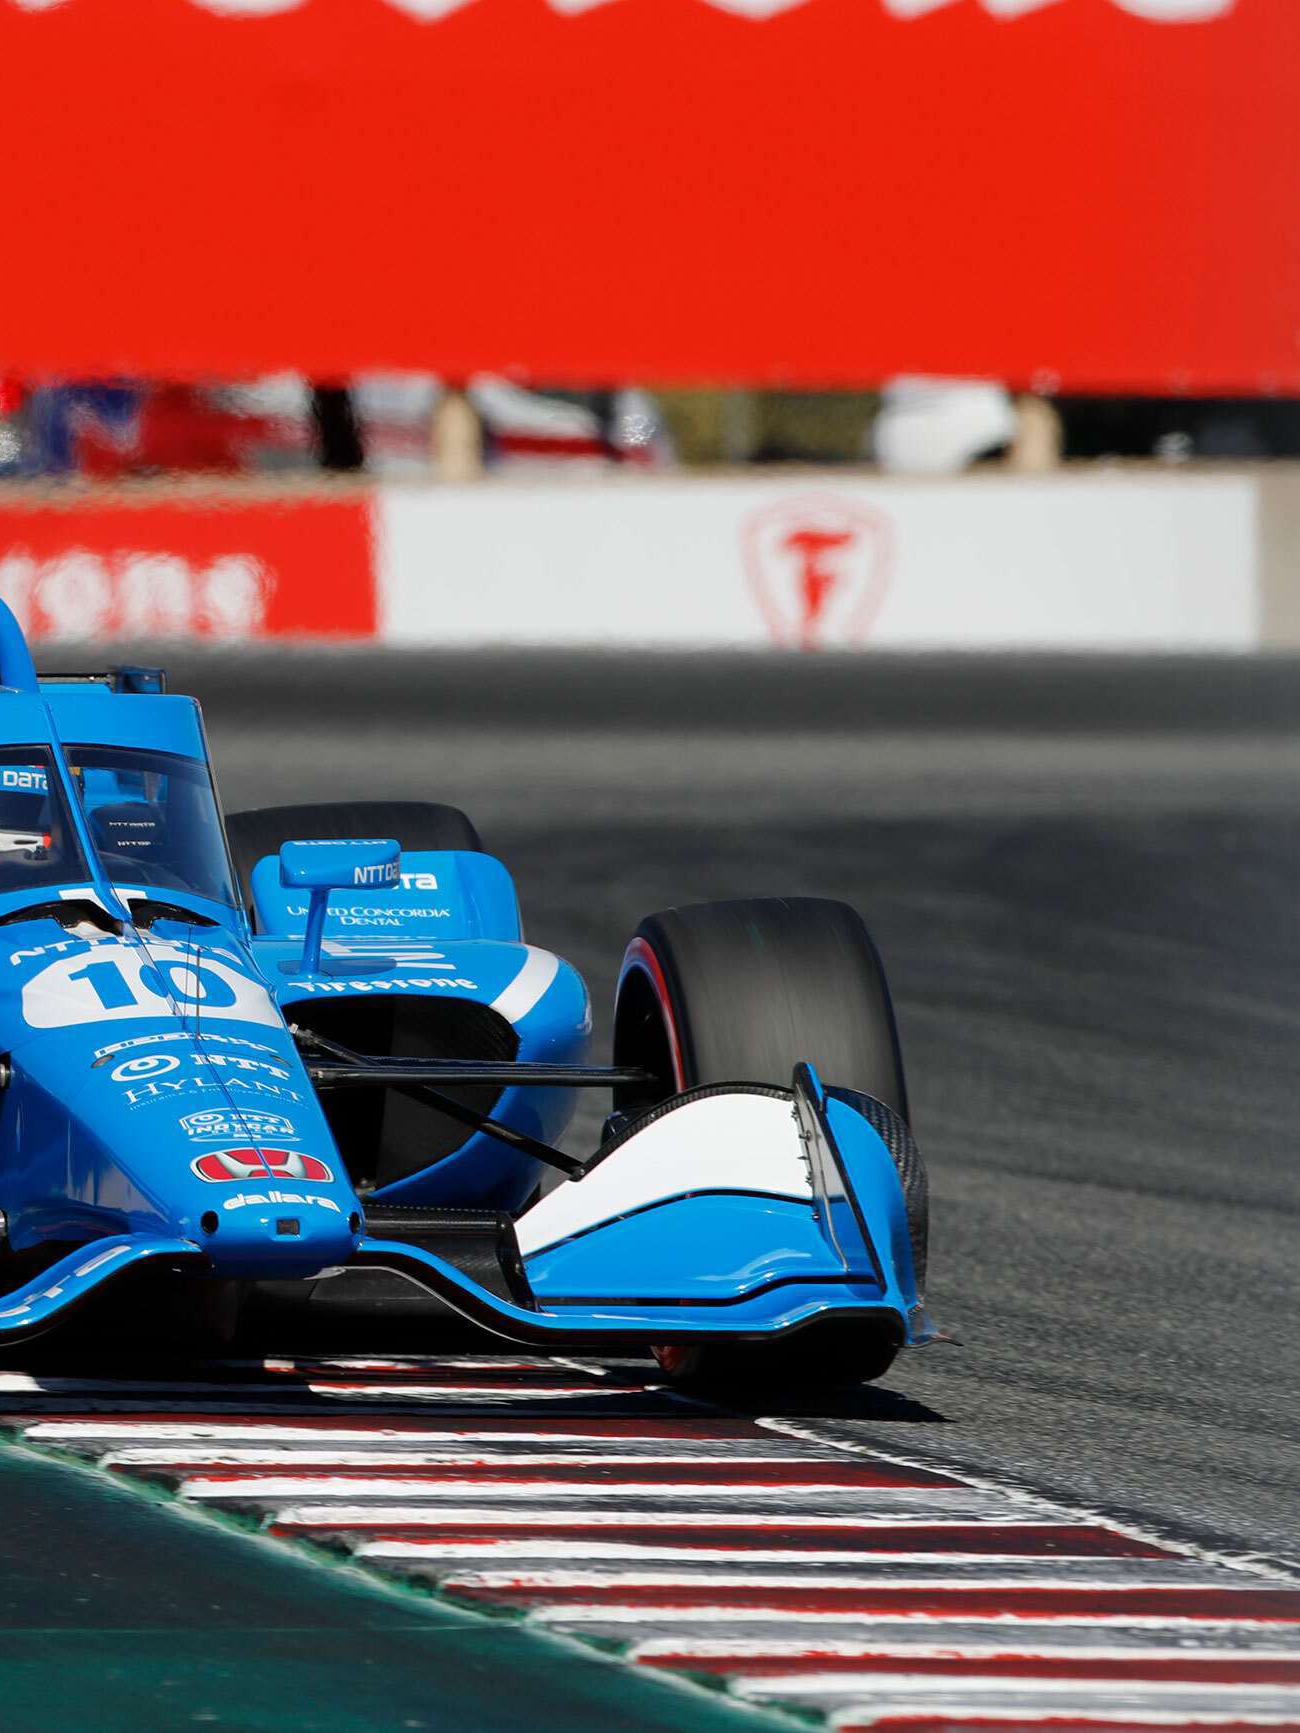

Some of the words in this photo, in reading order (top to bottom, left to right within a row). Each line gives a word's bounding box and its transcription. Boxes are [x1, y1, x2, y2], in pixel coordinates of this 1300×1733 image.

[353, 863, 385, 885] NTT
[340, 916, 405, 927] DENTAL
[67, 960, 237, 1011] 10
[189, 1053, 291, 1081] NTT
[121, 1077, 307, 1105] HYLANT
[223, 1190, 341, 1213] dallara
